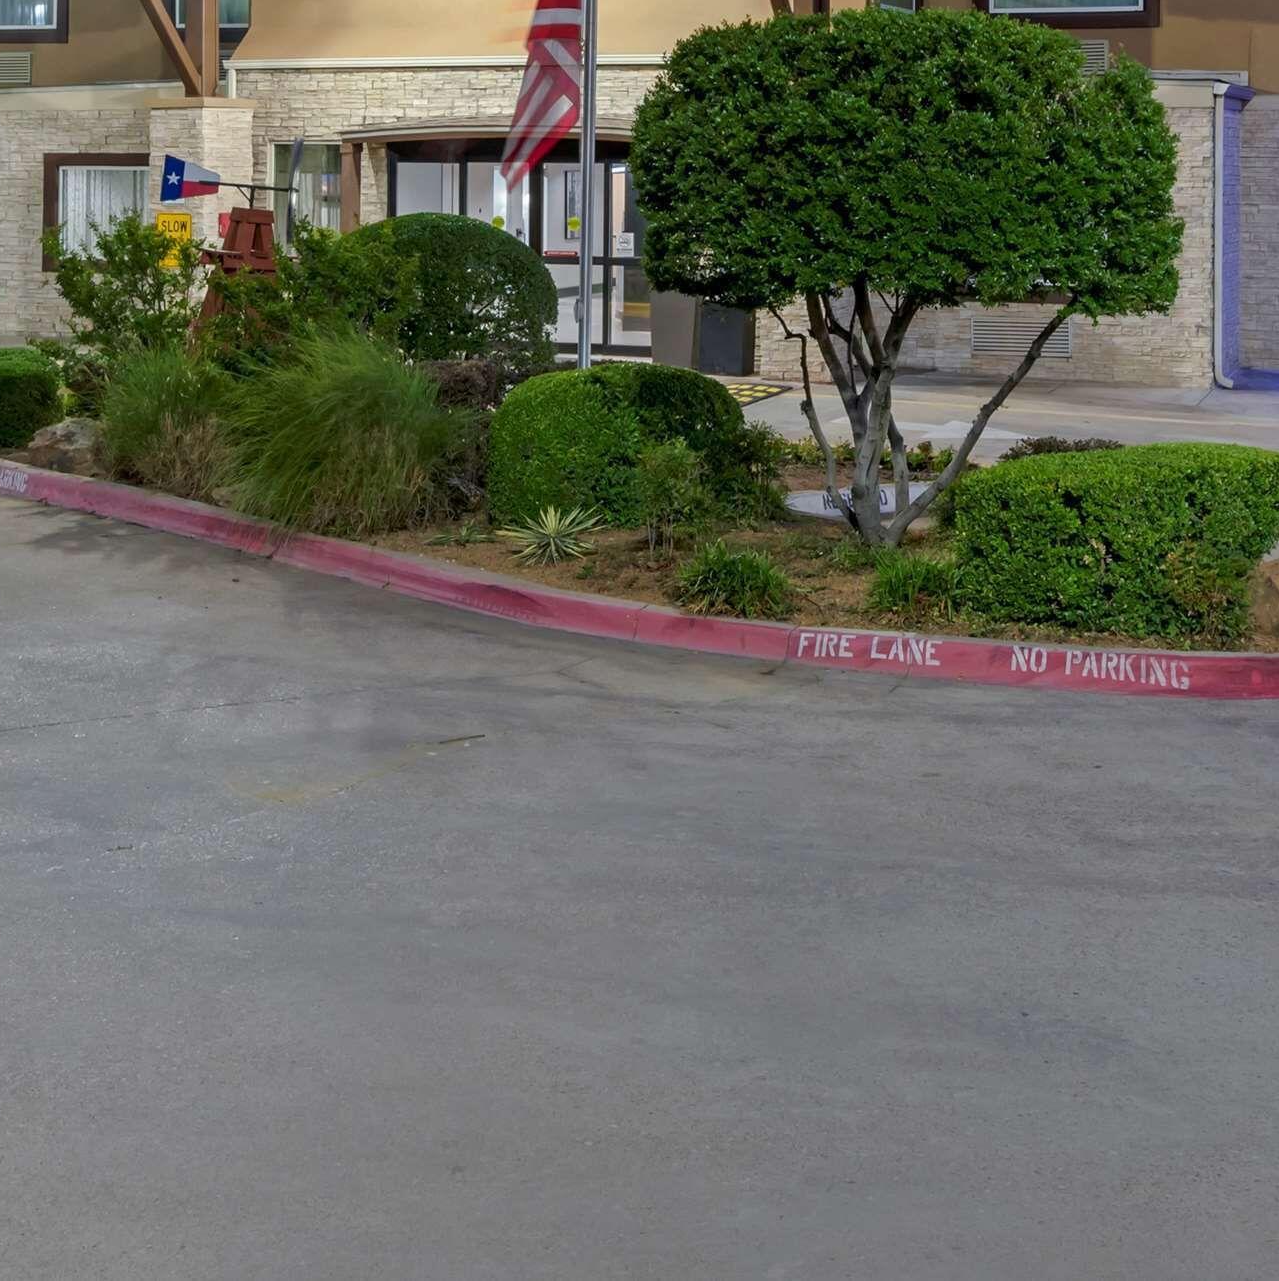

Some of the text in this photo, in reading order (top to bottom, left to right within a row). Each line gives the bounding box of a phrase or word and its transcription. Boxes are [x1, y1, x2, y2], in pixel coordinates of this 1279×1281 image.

[161, 220, 188, 233] SLOW
[797, 632, 1191, 691] FIRE LANE NO PARKING
